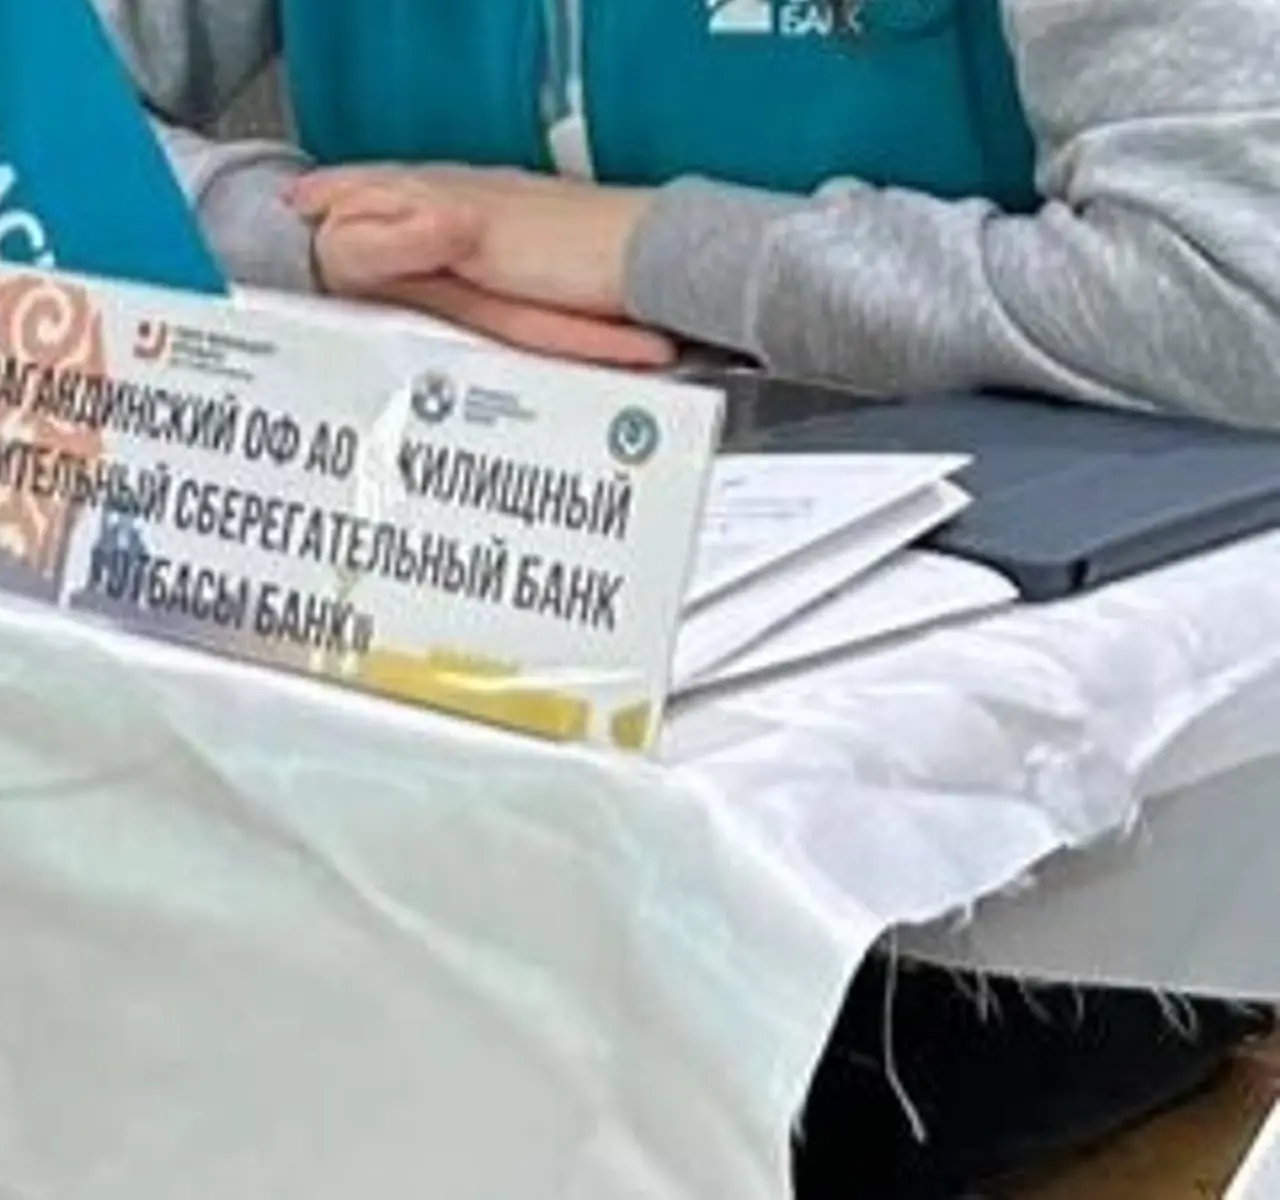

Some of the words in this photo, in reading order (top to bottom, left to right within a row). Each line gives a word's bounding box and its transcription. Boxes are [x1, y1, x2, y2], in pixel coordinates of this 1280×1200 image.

[242, 406, 302, 468] ОФ
[304, 420, 359, 482] АО
[174, 477, 508, 603] СБЕРЕГАТЕЛЬНЫЙ
[511, 553, 626, 633] БАНК
